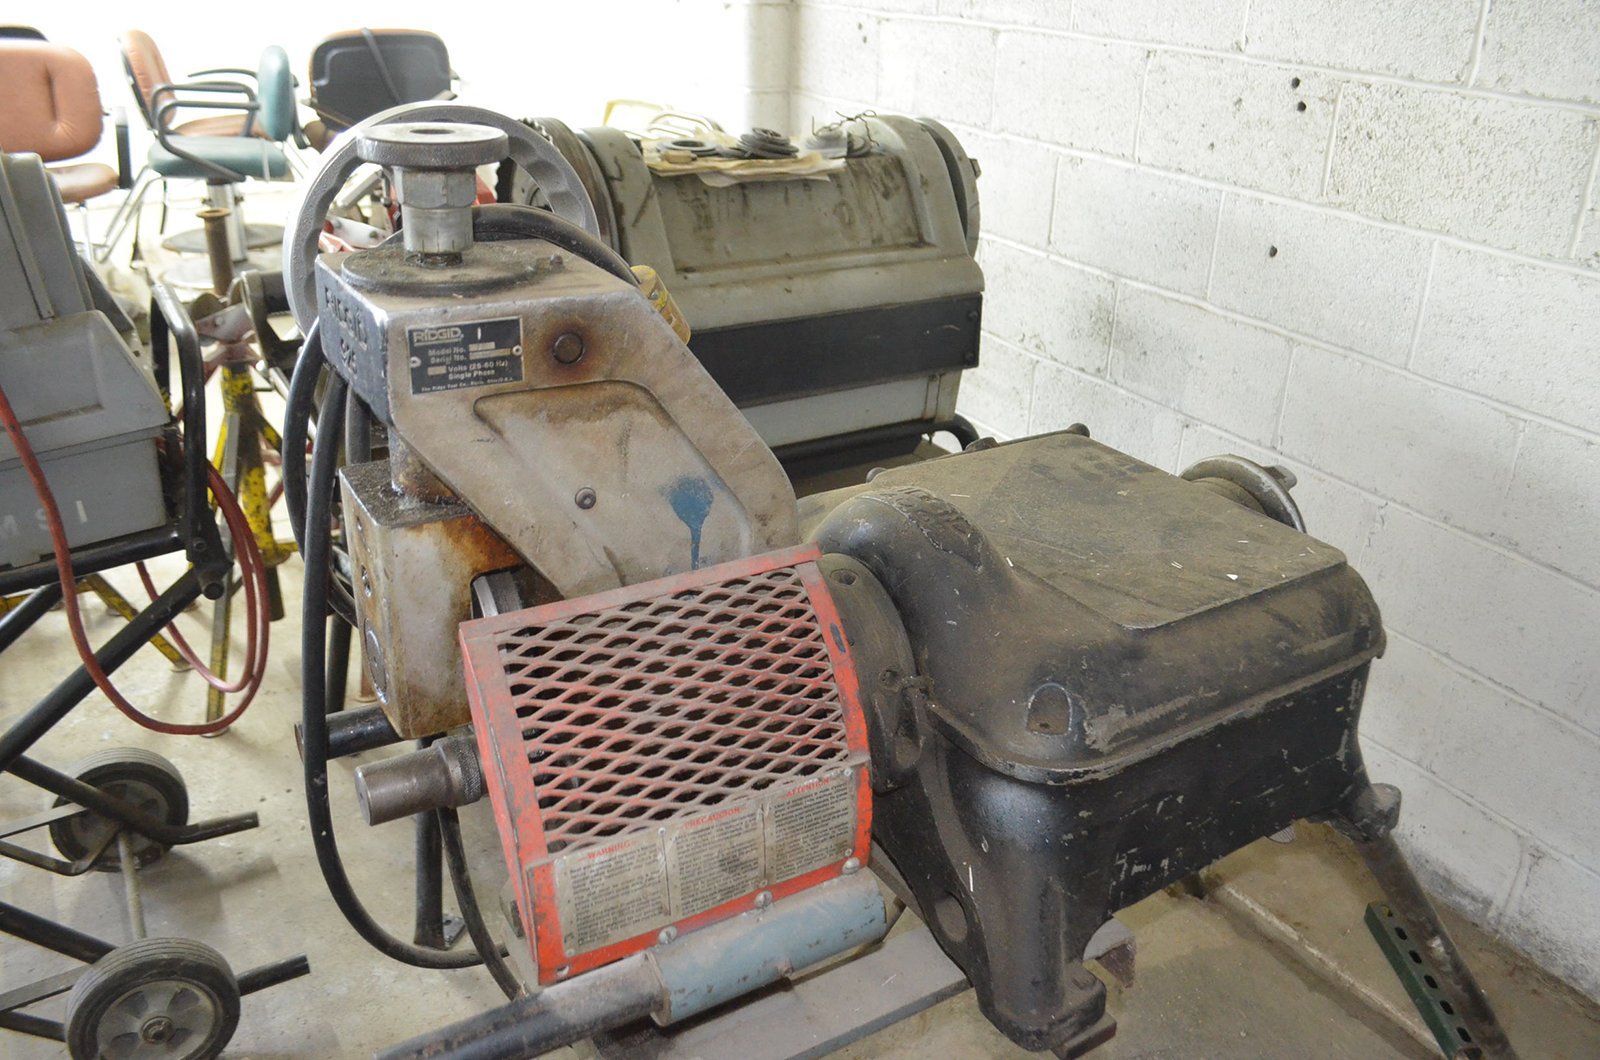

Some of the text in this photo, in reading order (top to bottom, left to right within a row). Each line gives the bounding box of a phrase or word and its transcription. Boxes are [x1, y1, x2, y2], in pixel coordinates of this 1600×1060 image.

[412, 327, 462, 343] RIDGID
[427, 346, 452, 356] Model
[447, 364, 468, 373] Volts
[448, 369, 496, 380] Single Phase
[785, 776, 831, 798] ATTENTION
[586, 839, 632, 860] WARNING
